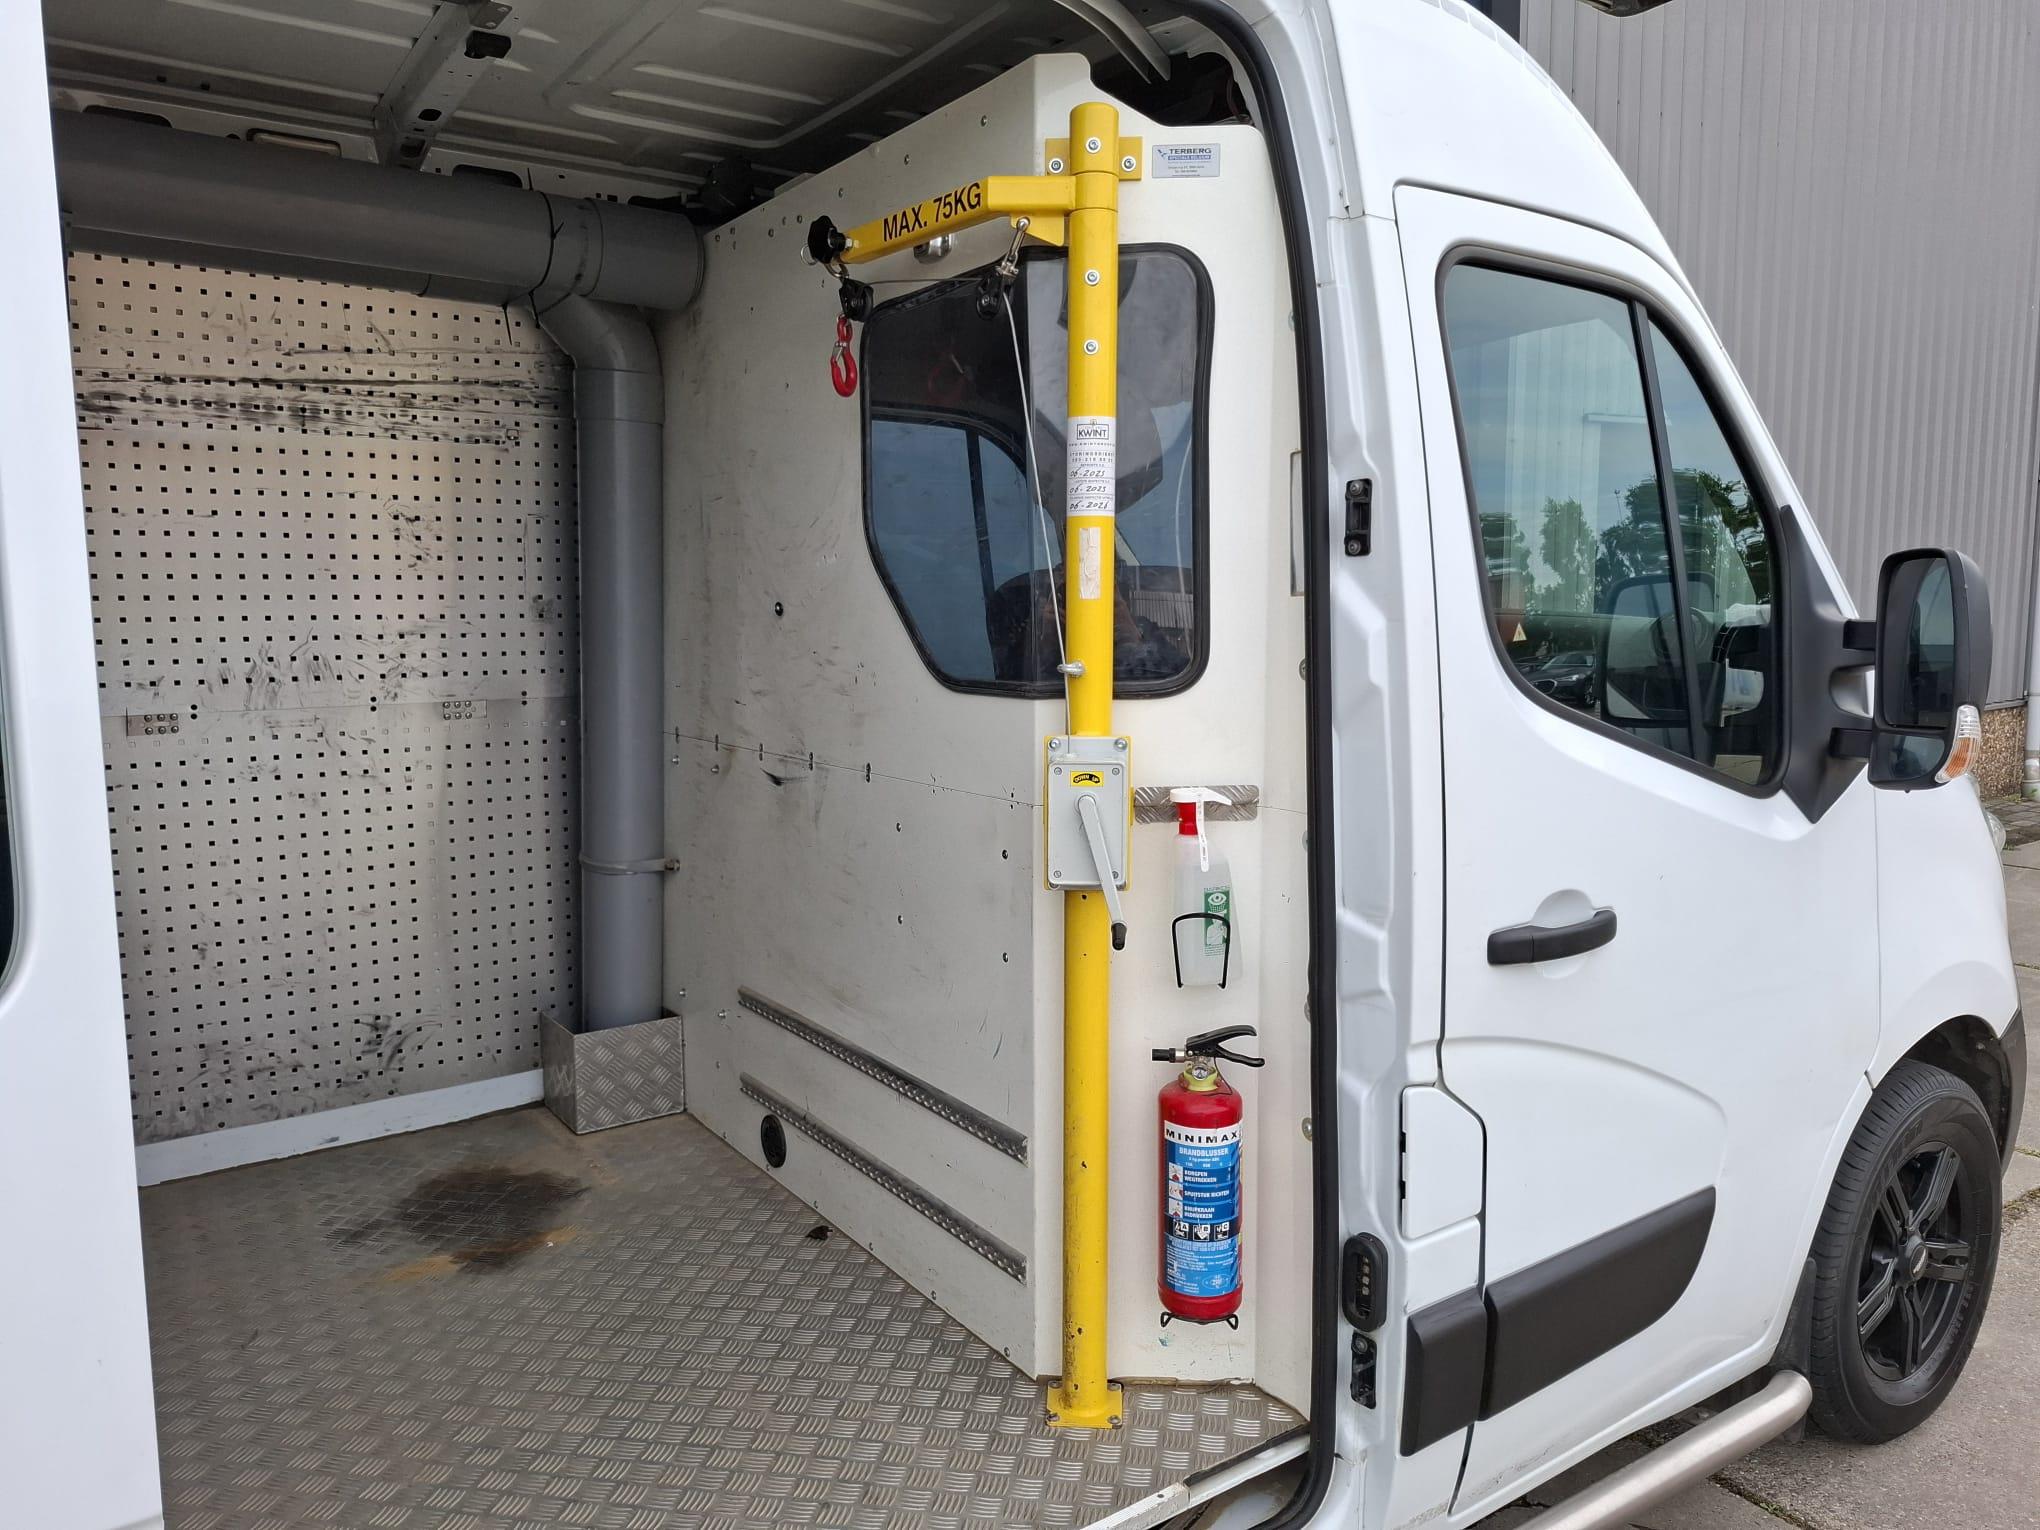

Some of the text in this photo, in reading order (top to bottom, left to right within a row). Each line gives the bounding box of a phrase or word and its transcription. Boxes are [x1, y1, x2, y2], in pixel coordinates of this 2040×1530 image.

[883, 182, 982, 242] MAX. 75KG
[1078, 429, 1107, 437] KWINT
[1165, 1128, 1238, 1144] MINIMAX
[1179, 1147, 1229, 1157] BRANDBLUSSER
